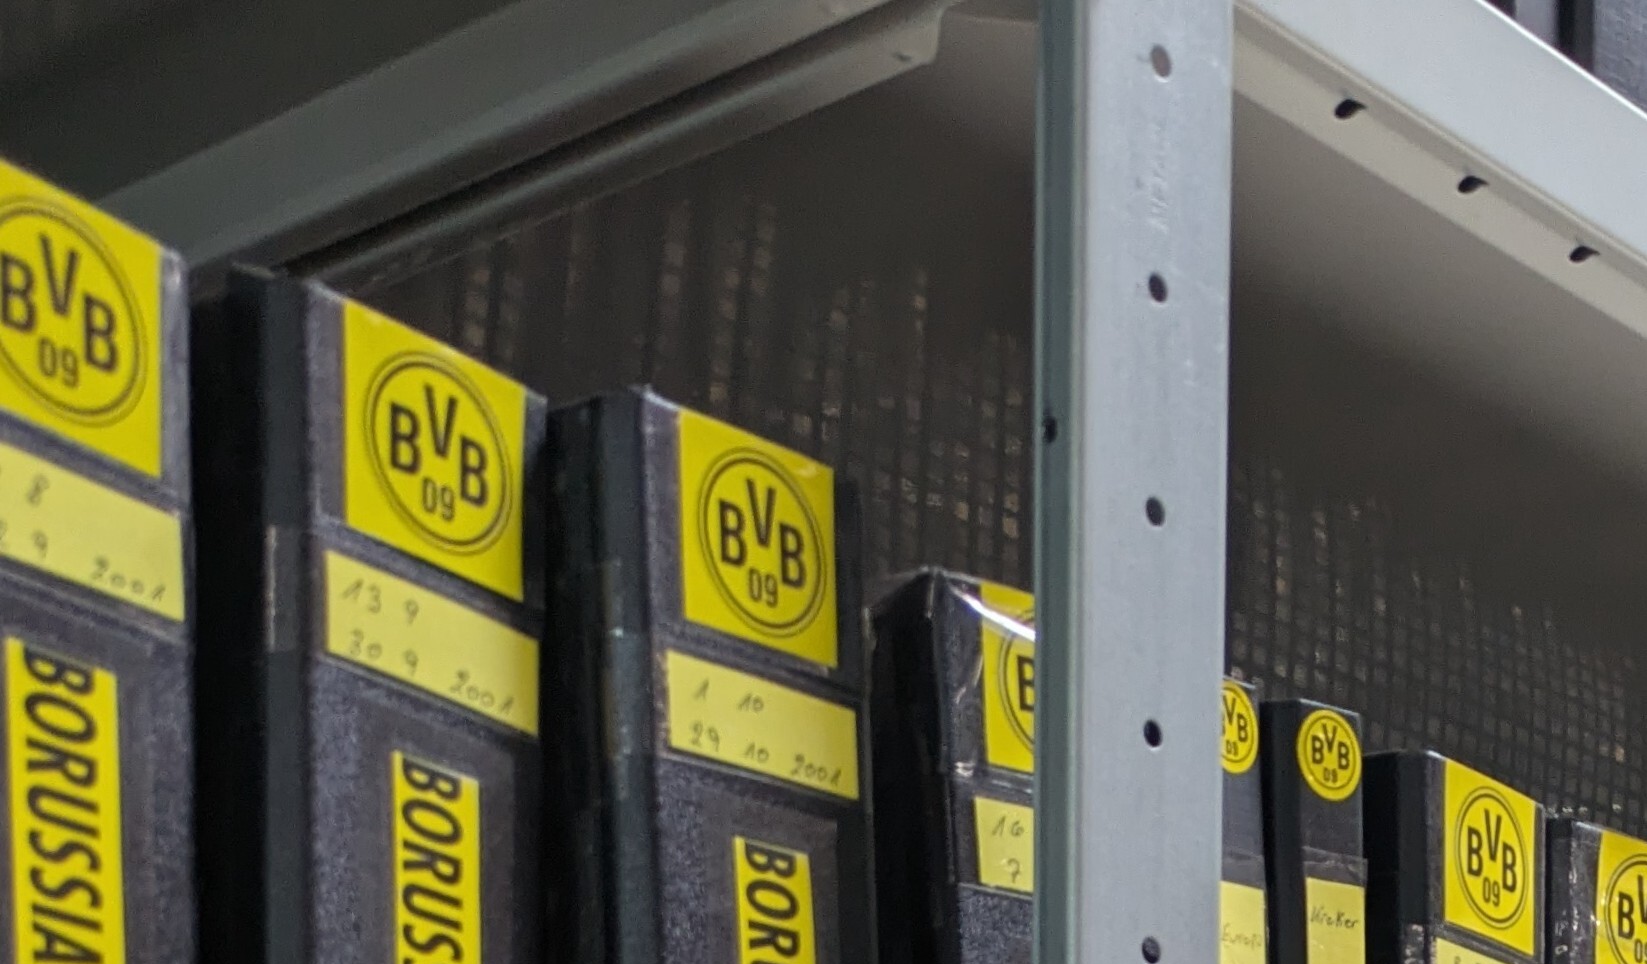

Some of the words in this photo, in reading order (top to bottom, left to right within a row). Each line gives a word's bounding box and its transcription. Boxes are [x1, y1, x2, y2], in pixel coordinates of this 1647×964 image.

[0, 232, 118, 373] BVB
[38, 336, 80, 389] 09
[389, 384, 489, 508] BVB
[420, 475, 455, 522] 09
[718, 478, 807, 590] BVB
[748, 568, 779, 608] 09
[737, 690, 765, 714] 10
[1222, 694, 1249, 743] VB
[745, 735, 770, 762] 10
[1311, 722, 1350, 771] BVB
[1467, 808, 1518, 894] BVB
[1482, 879, 1501, 908] 09
